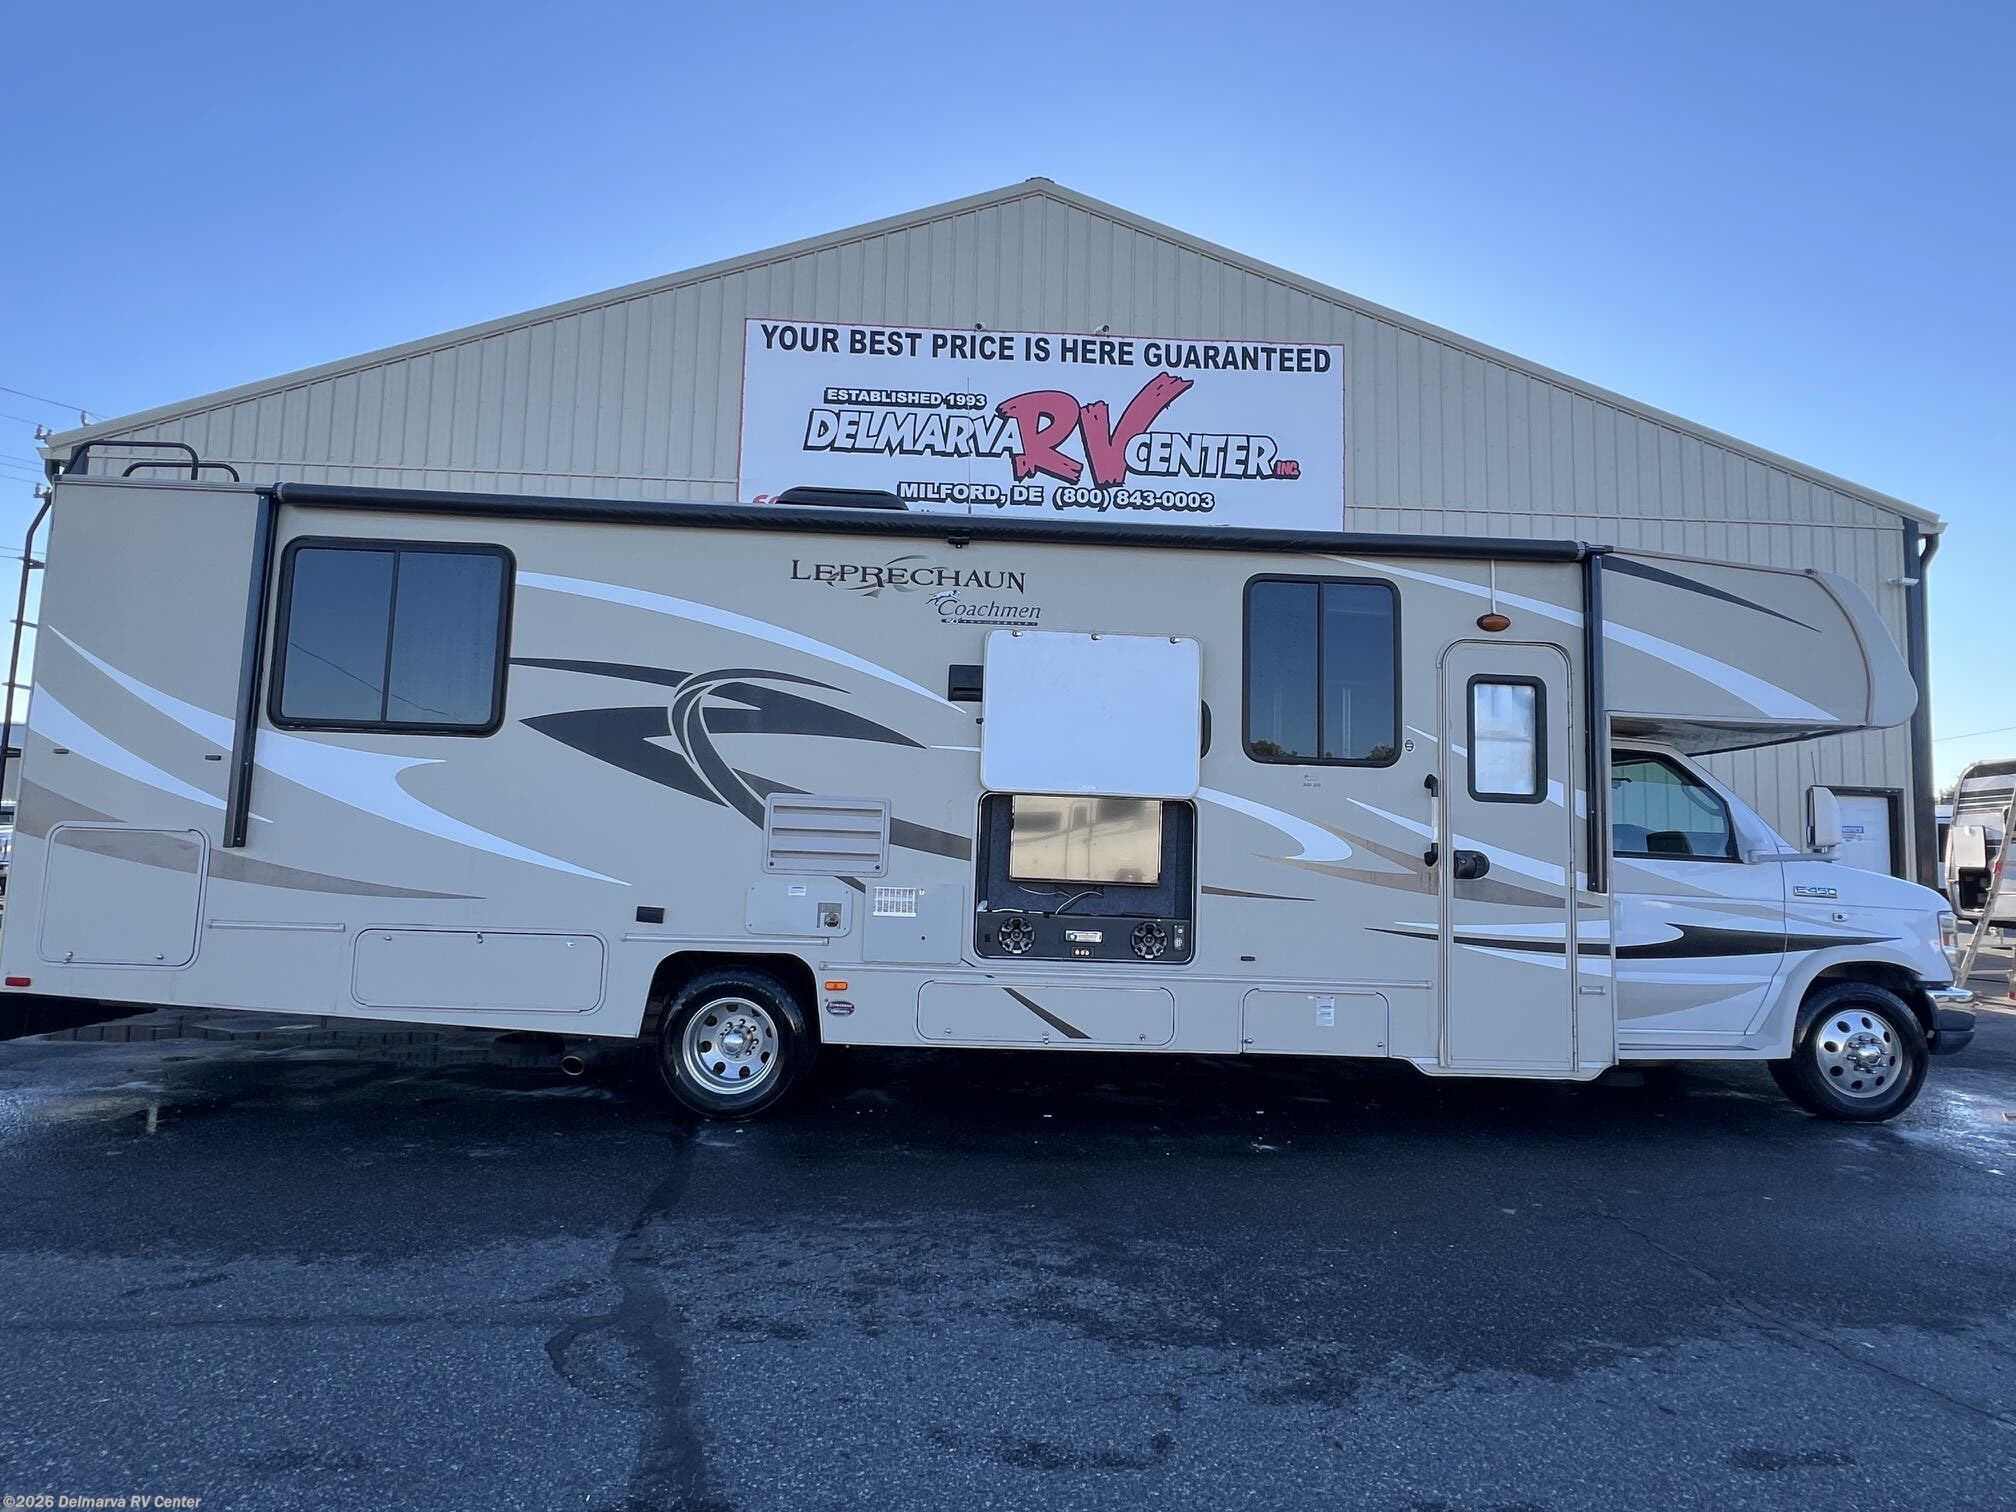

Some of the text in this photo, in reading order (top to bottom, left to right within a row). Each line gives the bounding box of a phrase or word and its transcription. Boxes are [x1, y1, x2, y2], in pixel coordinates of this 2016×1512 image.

[761, 324, 1331, 373] YOUR BEST PRICE IS HERE GUARANTEED
[824, 387, 987, 410] ESTABLISHED 1993
[803, 408, 1025, 458] DELMARVA
[996, 371, 1194, 487] RV
[1124, 432, 1277, 479] CENTER
[897, 482, 1214, 512] MILFORD, DE (800) 843-0003
[790, 559, 1026, 594] LEPRECHAUN
[937, 599, 1041, 619] Coachmen
